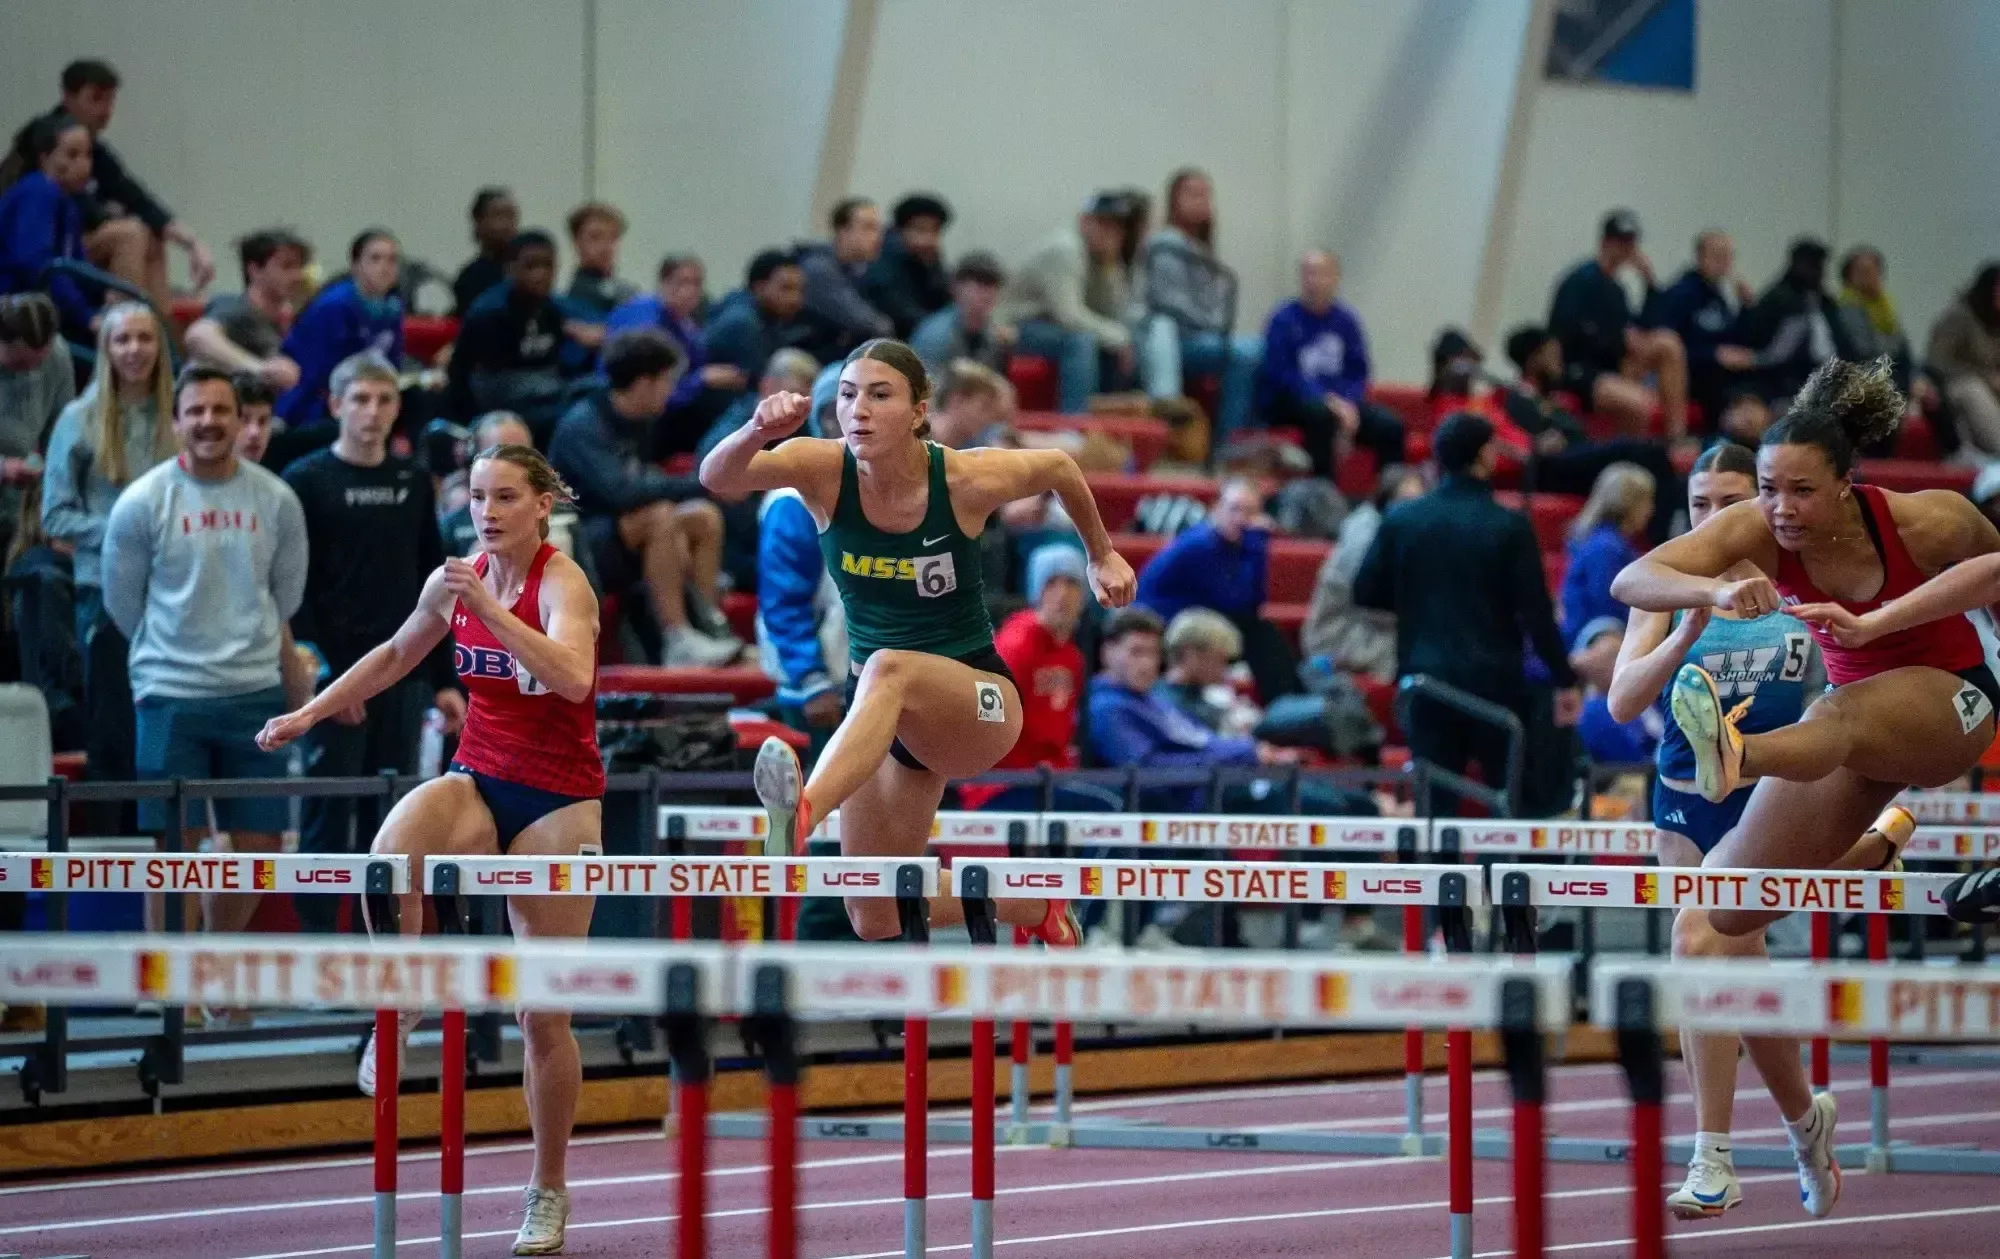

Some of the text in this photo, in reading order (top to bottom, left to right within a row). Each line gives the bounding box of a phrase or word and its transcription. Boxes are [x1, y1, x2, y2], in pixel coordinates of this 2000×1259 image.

[922, 560, 947, 595] 6
[1784, 638, 1805, 678] 5
[1709, 670, 1776, 682] ASHBURN
[1960, 688, 1983, 717] 4
[1168, 821, 1219, 843] PITT
[1226, 823, 1299, 846] STATE
[1558, 828, 1616, 849] PITT
[67, 860, 352, 889] PITT STATE UCS
[477, 863, 881, 893] UCS PITT STATE UCS
[1006, 868, 1422, 899] UCS PITT STATE UCS
[1548, 875, 1864, 909] UCS PITT STATE
[190, 952, 296, 998] PITT
[316, 953, 461, 1000] STATE
[1128, 967, 1288, 1017] STATE
[820, 1123, 869, 1137] UCS
[1206, 1132, 1259, 1147] UCS
